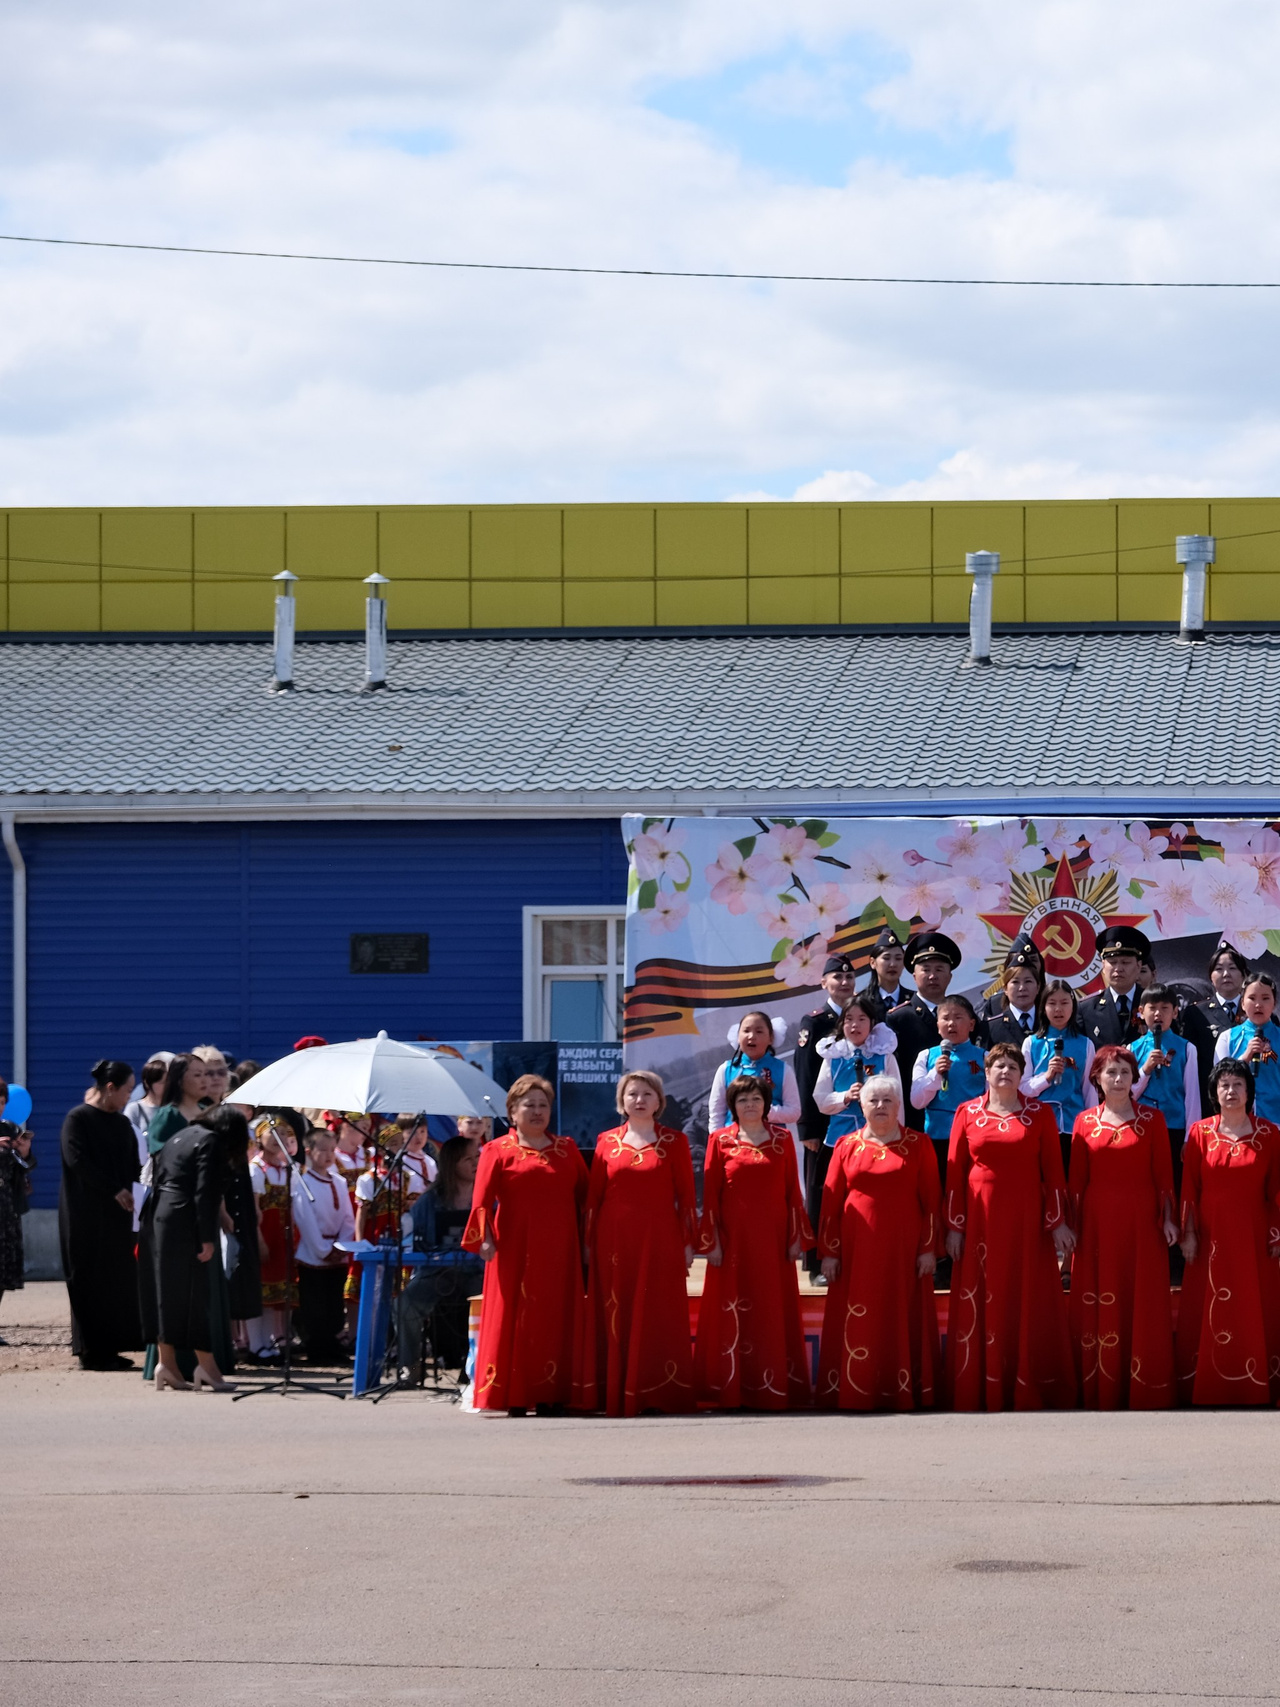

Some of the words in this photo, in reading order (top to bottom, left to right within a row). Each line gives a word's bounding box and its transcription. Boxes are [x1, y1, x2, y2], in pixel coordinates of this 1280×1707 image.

[1023, 899, 1101, 931] СТВЕННАЯ
[558, 1048, 597, 1060] АЖДОМ
[599, 1048, 624, 1060] СЕРД
[570, 1060, 615, 1071] ЗАБЫТЫ
[563, 1073, 608, 1083] ПАВШИХ
